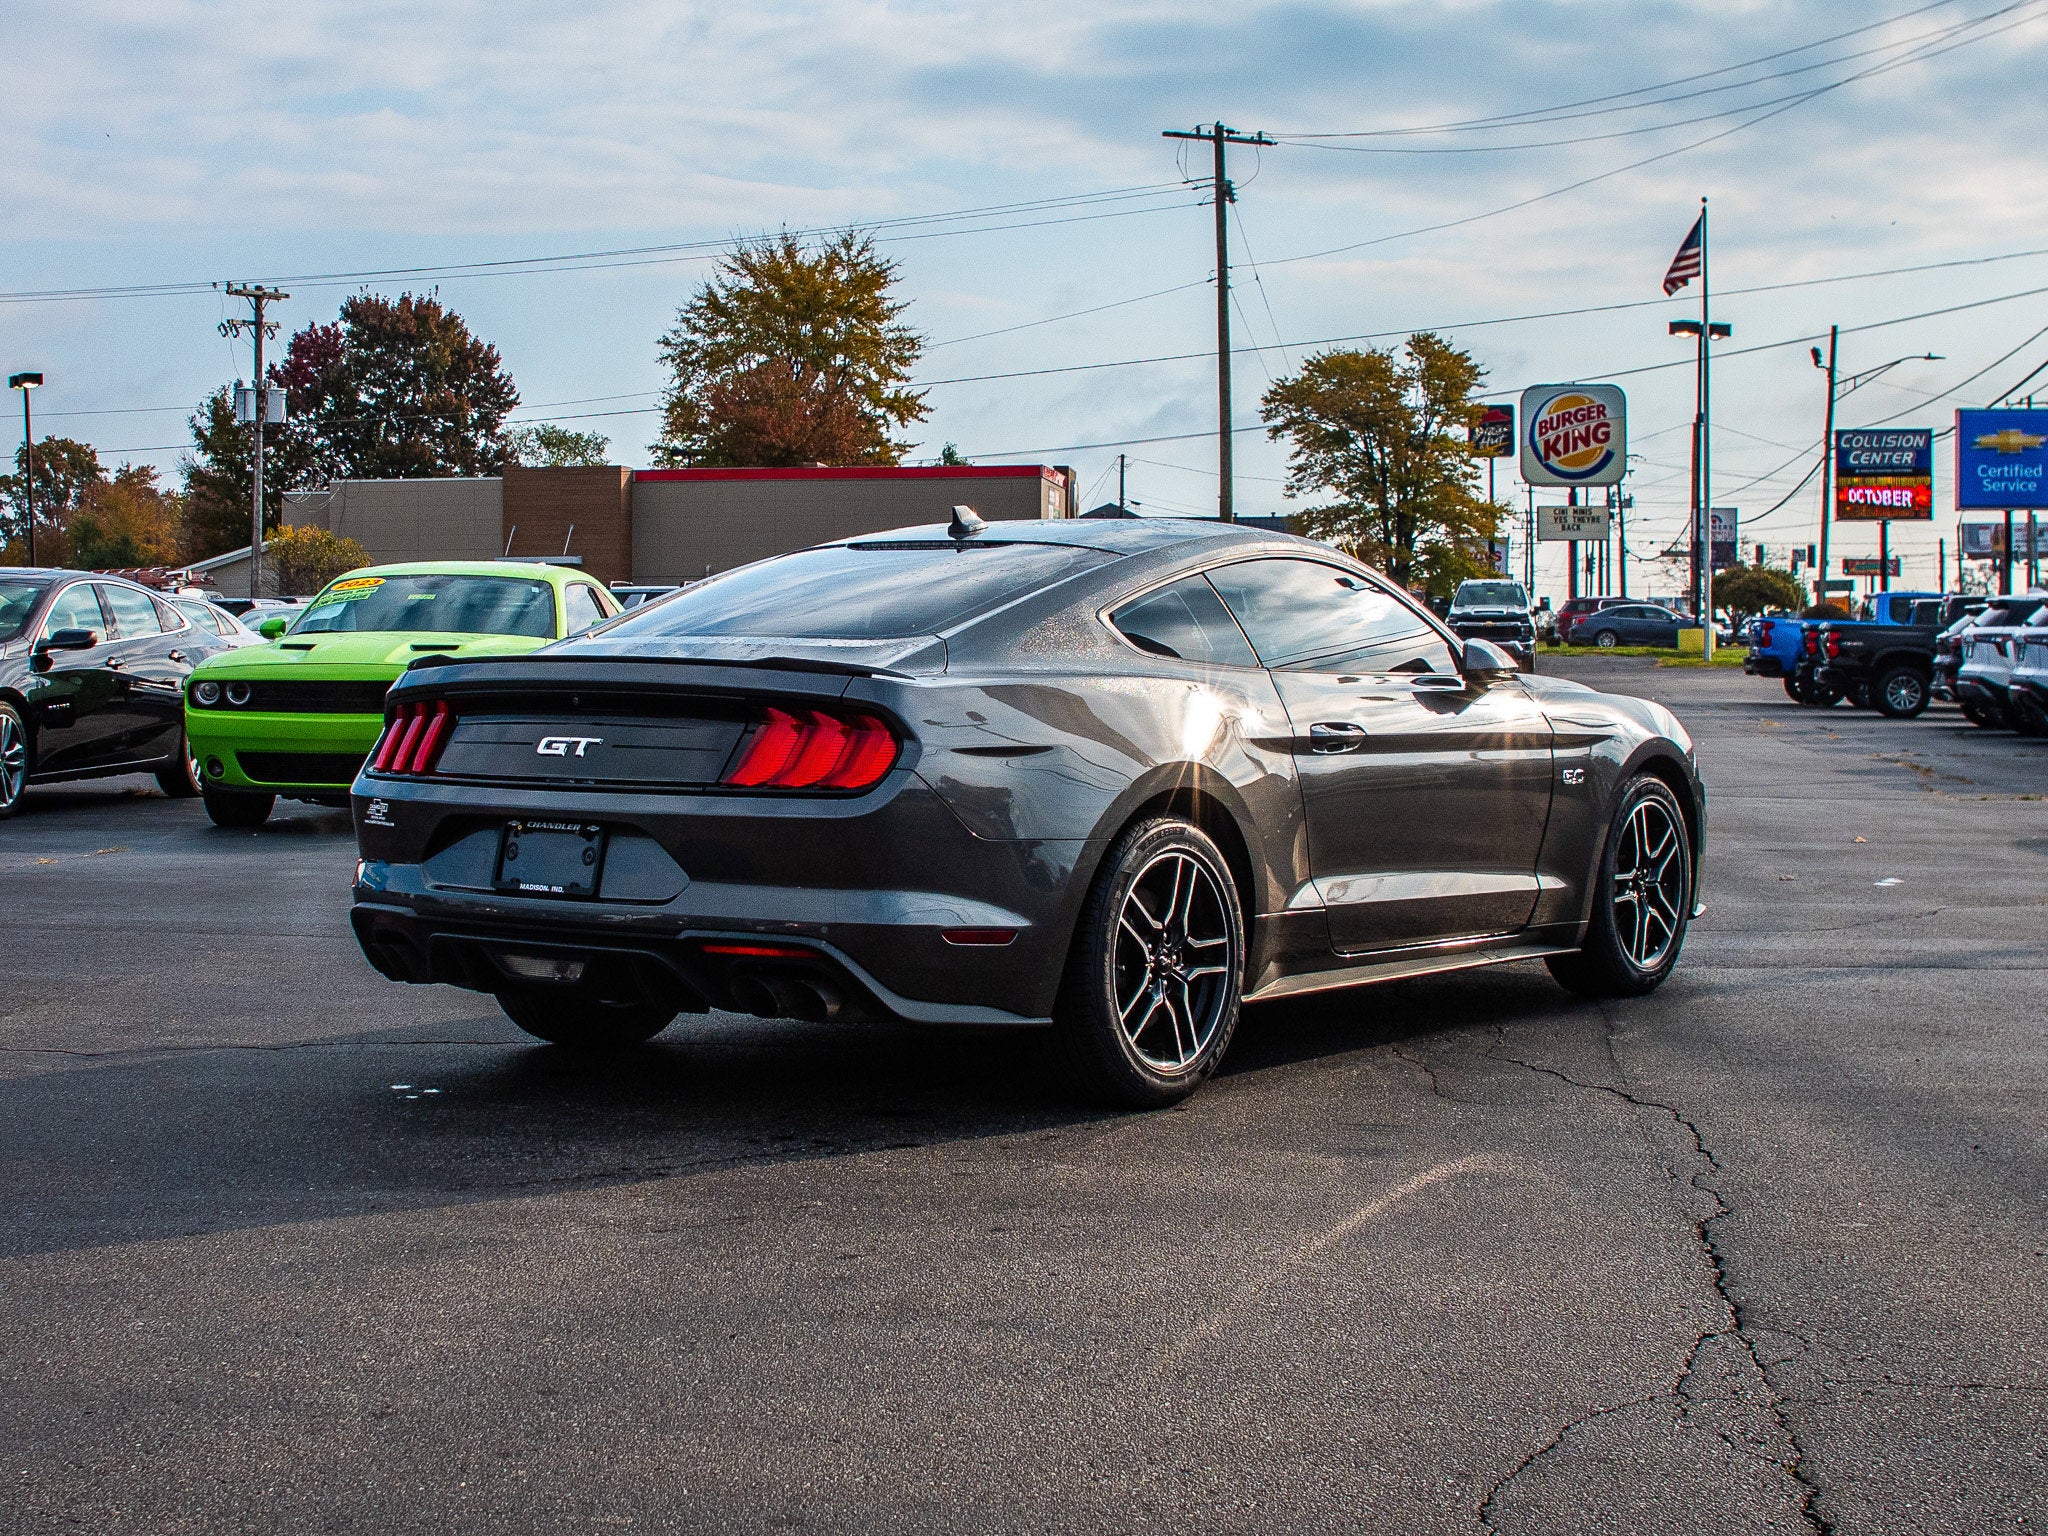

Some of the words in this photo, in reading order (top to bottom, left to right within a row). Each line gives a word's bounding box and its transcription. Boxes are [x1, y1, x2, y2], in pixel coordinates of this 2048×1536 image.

[1537, 404, 1607, 438] BURGER
[1541, 421, 1611, 463] KING
[1840, 434, 1926, 449] COLLISION
[1849, 450, 1915, 465] CENTER
[1977, 464, 2043, 478] Certified
[1982, 479, 2038, 492] Service
[1848, 487, 1913, 508] OCTOBER
[1553, 516, 1568, 524] YES
[1561, 524, 1582, 532] BACK
[536, 736, 604, 758] GT
[526, 820, 581, 832] CHANDLER
